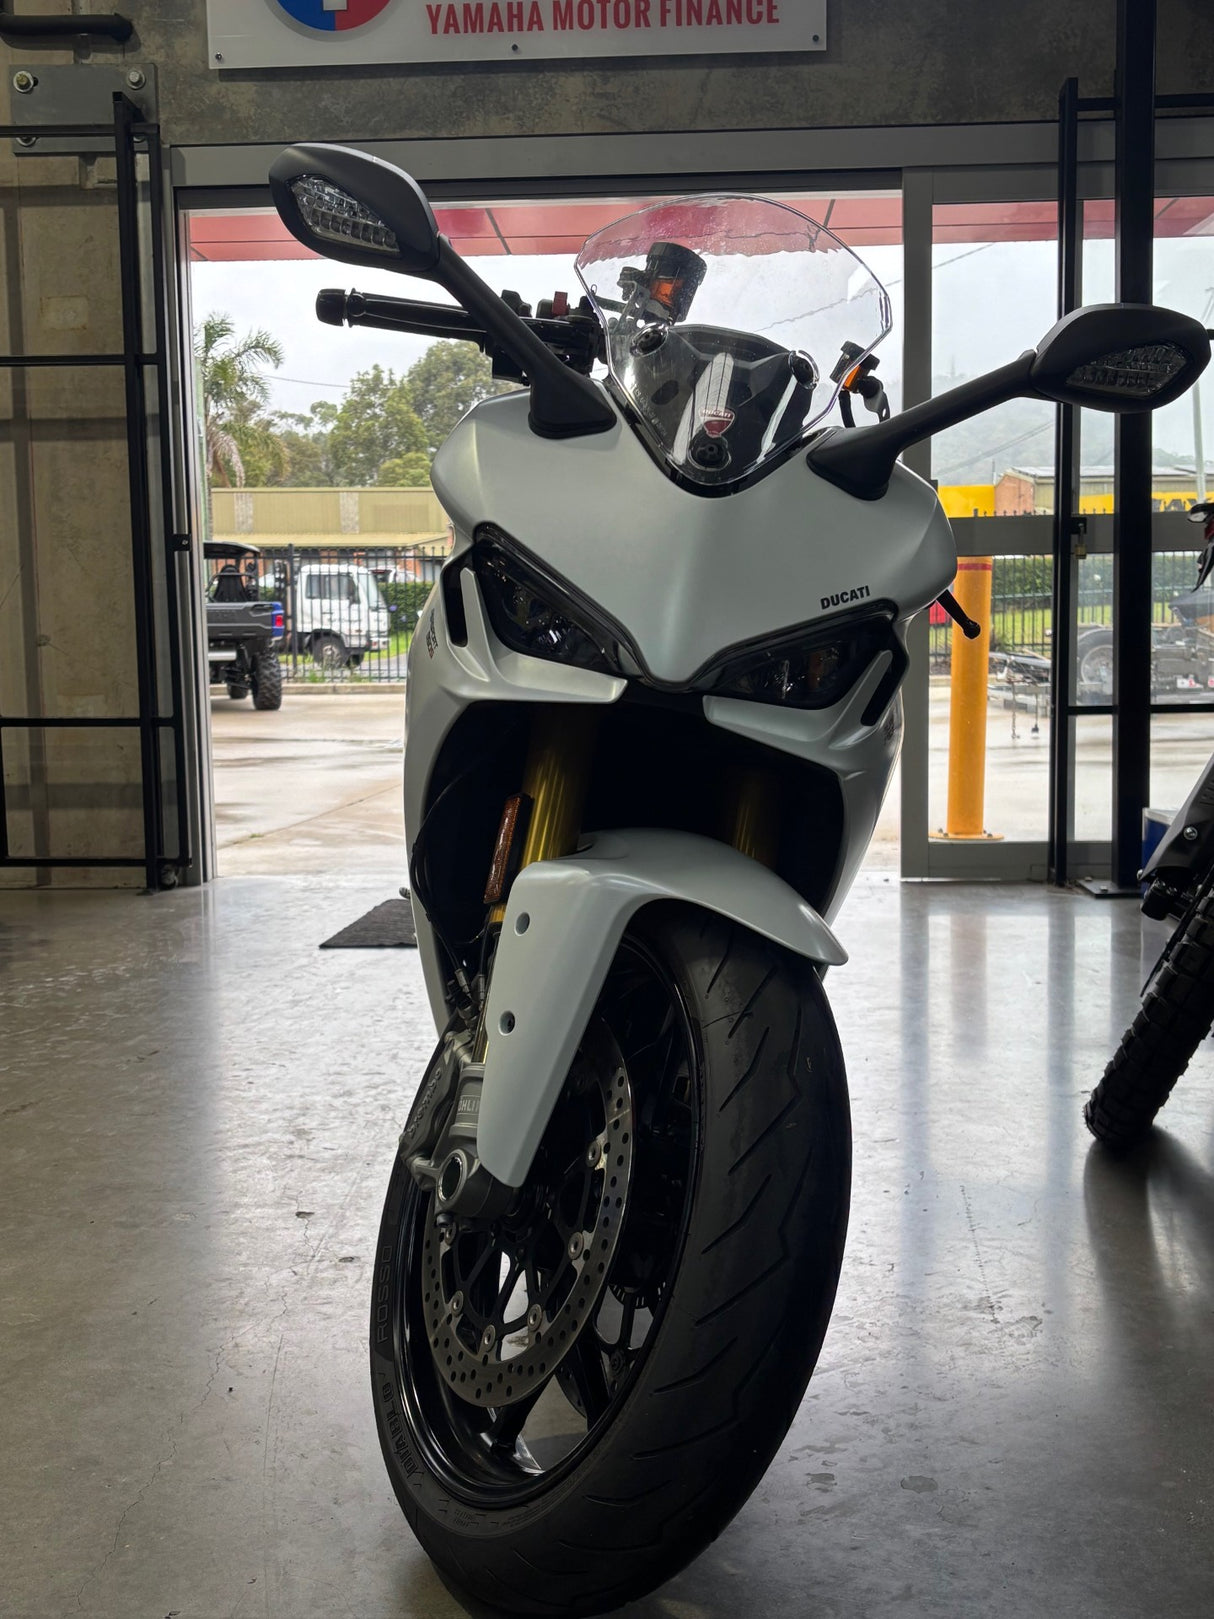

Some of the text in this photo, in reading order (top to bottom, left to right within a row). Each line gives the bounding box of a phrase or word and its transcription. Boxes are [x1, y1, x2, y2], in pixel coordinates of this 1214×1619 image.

[426, 0, 779, 34] YAMAHA MOTOR FINANCE
[820, 585, 870, 610] DUCATI
[377, 1245, 392, 1344] ROSSO
